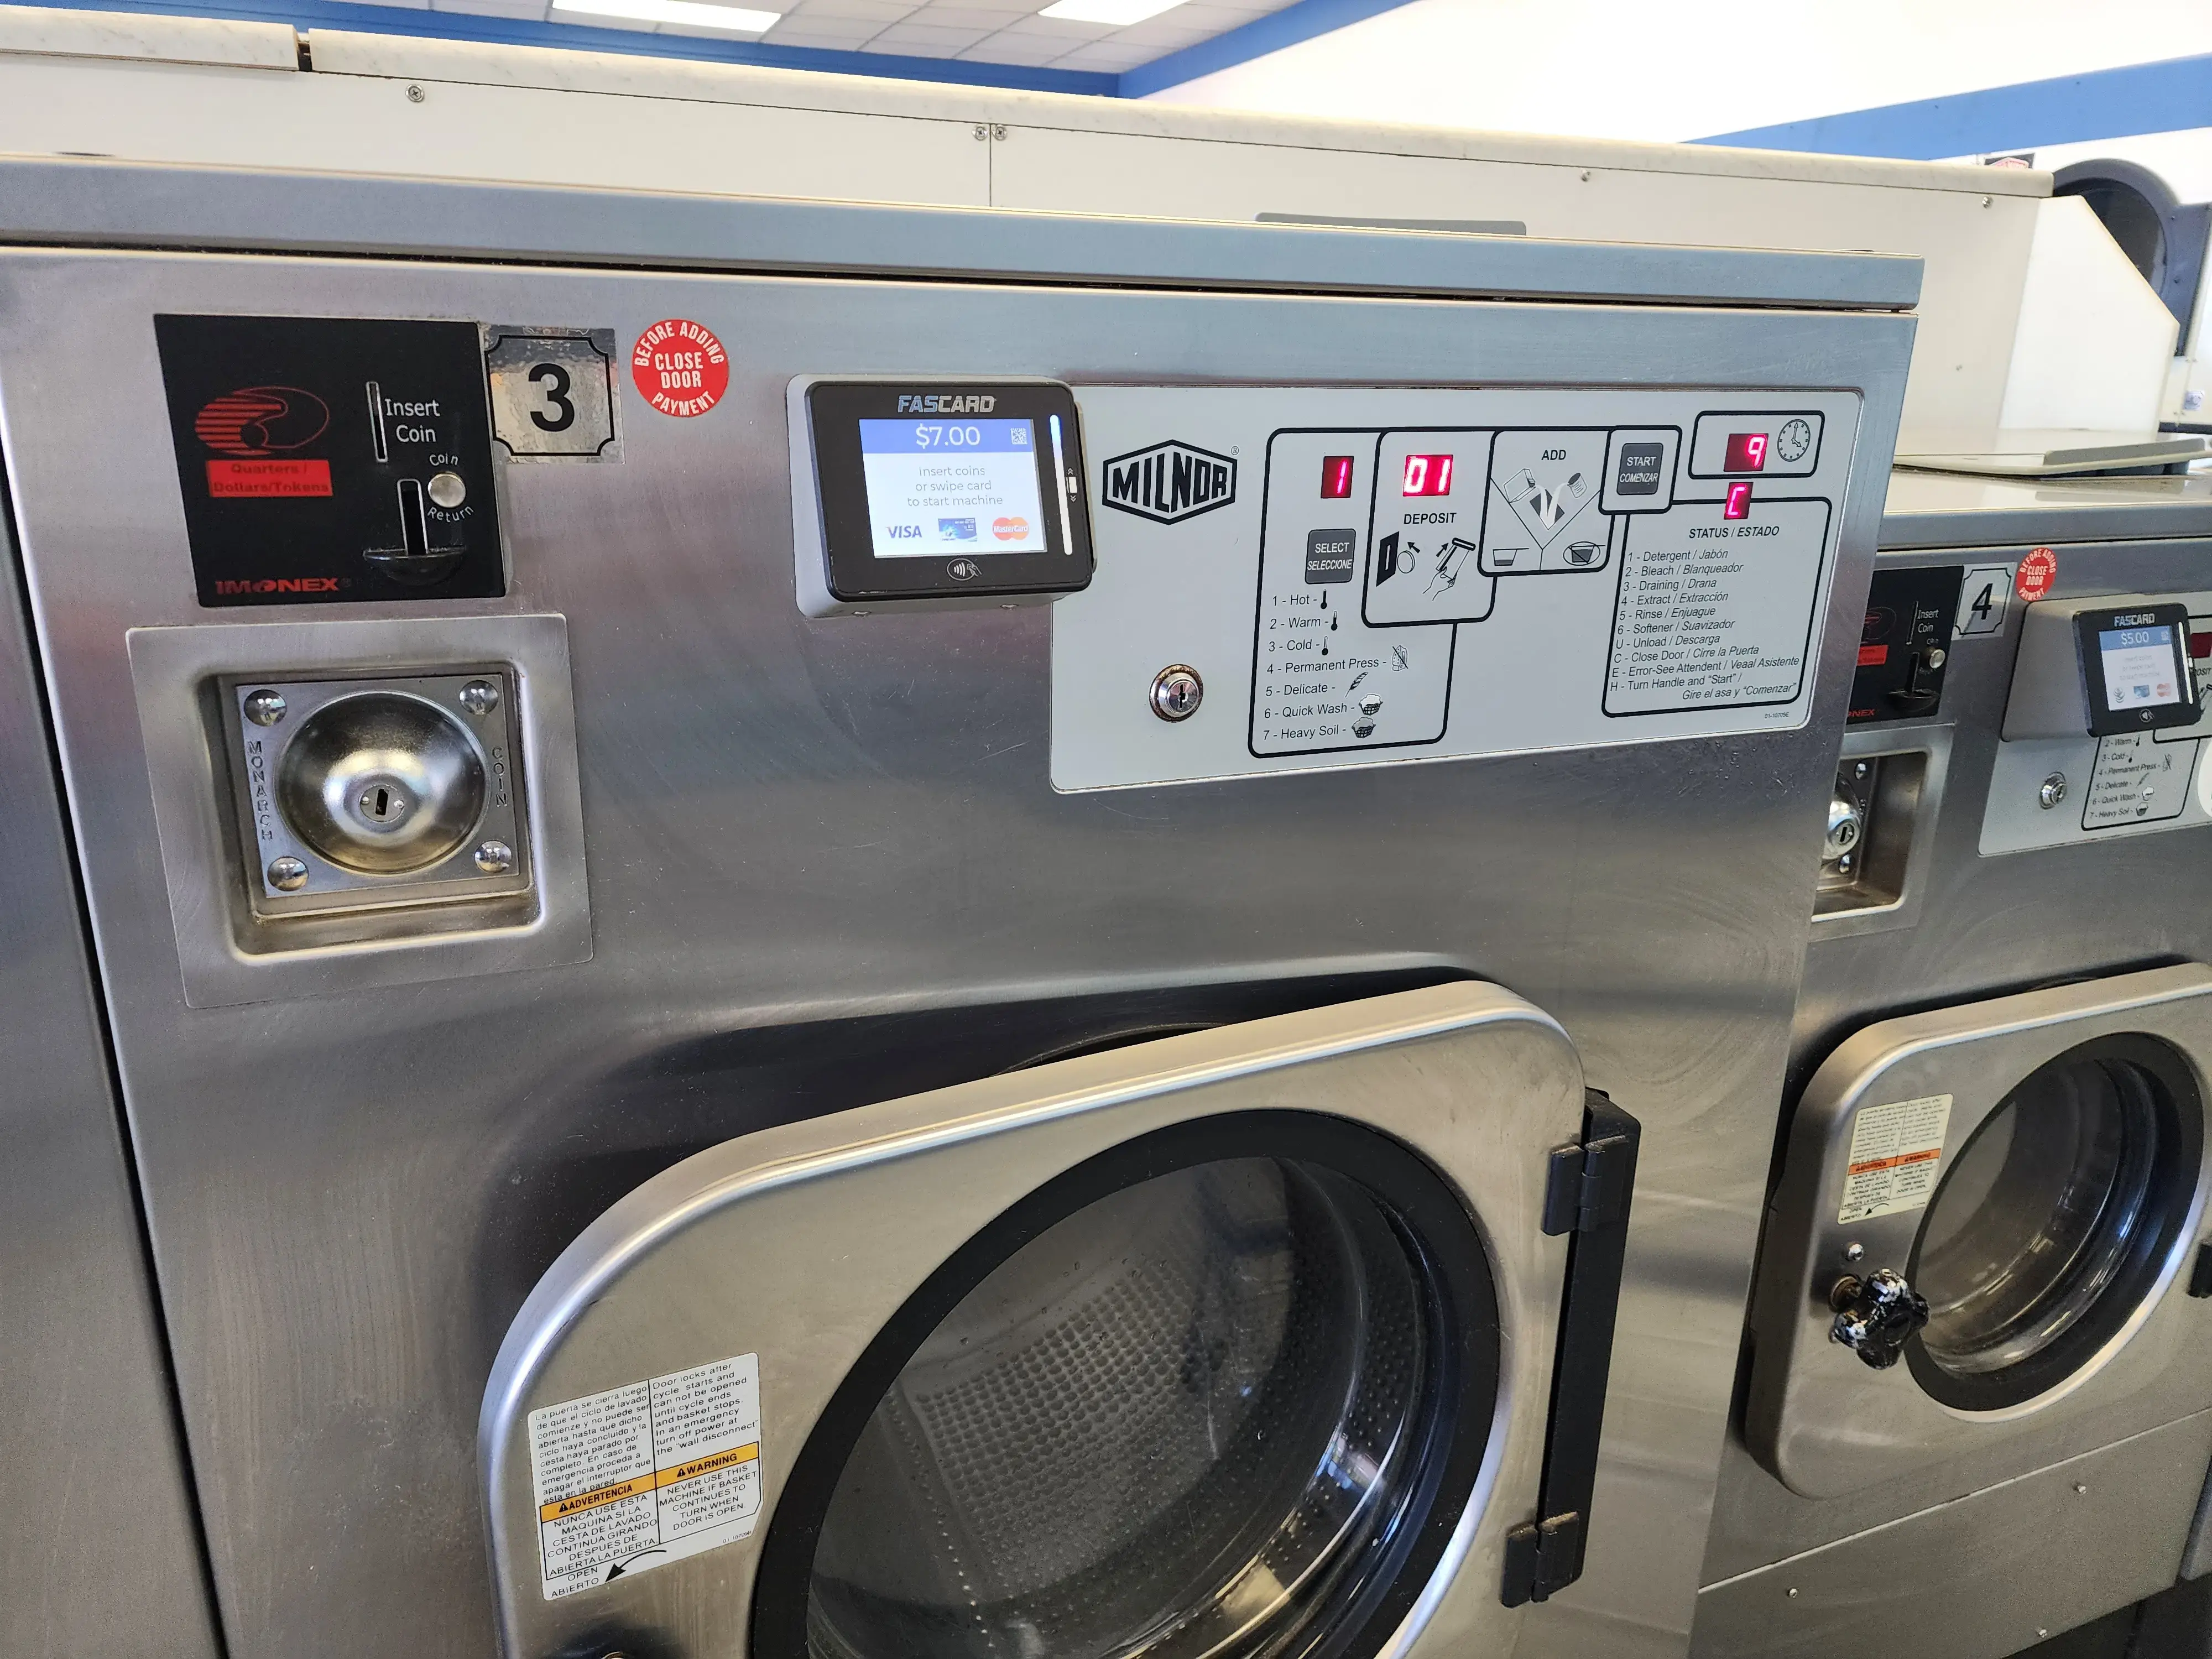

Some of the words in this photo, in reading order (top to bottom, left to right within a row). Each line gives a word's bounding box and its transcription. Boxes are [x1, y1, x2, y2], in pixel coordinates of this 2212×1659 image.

[635, 322, 675, 367] BEFORE
[680, 322, 724, 364] ADDING
[655, 352, 703, 371] CLOSE
[660, 371, 702, 389] DOOR
[528, 363, 575, 432] 3
[652, 391, 715, 415] PAYMENT
[898, 395, 996, 413] FASCARD
[385, 399, 440, 417] Insert
[396, 426, 436, 443] Coin
[916, 423, 980, 448] $7.00
[1542, 449, 1567, 461] ADD
[1747, 436, 1766, 467] 9
[429, 455, 458, 467] Coin
[1626, 455, 1657, 468] START
[919, 466, 952, 476] Insert
[956, 467, 985, 476] coins
[1619, 472, 1658, 484] COMENZAR
[915, 483, 927, 491] or
[931, 482, 963, 493] swipe
[967, 481, 992, 491] card
[1113, 452, 1227, 513] MILNOR
[907, 497, 920, 507] to
[923, 497, 949, 507] start
[952, 495, 1003, 505] machine
[427, 506, 474, 523] Return
[1403, 512, 1457, 525] DEPOSIT
[886, 525, 922, 539] VISA
[1689, 528, 1728, 538] STATUS
[1737, 526, 1779, 536] ESTADO
[1314, 542, 1349, 553] SELECT
[1628, 552, 1632, 561] 1
[1643, 550, 1691, 563] Detergent
[1699, 548, 1728, 559] Jabón
[1307, 559, 1352, 570] SELECCIONE
[1625, 566, 1631, 577] 2
[1641, 565, 1673, 576] Bleach
[1683, 562, 1744, 575] Blanqueador
[1623, 581, 1629, 591] 3
[1639, 580, 1679, 591] Draining
[1687, 578, 1717, 588] Drana
[1272, 595, 1276, 606] 1
[1290, 594, 1310, 605] Hot
[1621, 596, 1627, 606] 4
[1637, 594, 1671, 604] Extract
[1679, 591, 1728, 603] Extracción
[1970, 583, 1994, 620] 4
[1619, 611, 1625, 620] 5
[1635, 609, 1662, 619] Rinse
[1671, 607, 1715, 619] Enjuague
[1917, 609, 1939, 619] Insert
[2114, 613, 2155, 627] FASCARD
[1270, 618, 1276, 629] 2
[1288, 617, 1320, 628] Warm
[1618, 625, 1624, 634] 6
[1633, 623, 1673, 633] Softener
[1682, 619, 1735, 630] Suavizador
[1918, 623, 1934, 633] Coin
[1269, 641, 1275, 651] 3
[1287, 639, 1312, 650] Cold
[1616, 639, 1623, 649] U
[1633, 636, 1666, 648] Unload
[1675, 635, 1720, 645] Descarga
[2121, 631, 2149, 645] $5.00
[1614, 653, 1621, 663] C
[1631, 652, 1658, 661] Close
[1661, 650, 1684, 660] Door
[1693, 648, 1715, 658] Cirre
[1717, 647, 1726, 656] la
[1729, 645, 1759, 655] Puerta
[1266, 664, 1273, 674] 4
[1285, 659, 1345, 673] Permanent
[1349, 658, 1379, 669] Press
[1612, 667, 1619, 677] E
[1629, 664, 1674, 676] Error-See
[1676, 661, 1721, 672] Attendent
[1756, 656, 1799, 667] Asistente
[1266, 686, 1272, 696] 5
[1284, 683, 1327, 695] Delicate
[1610, 681, 1618, 691] H
[1627, 680, 1648, 690] Turn
[1651, 677, 1684, 688] Handle
[1687, 675, 1705, 685] and
[1682, 690, 1701, 700] Gire
[1704, 688, 1713, 698] el
[1733, 688, 1740, 698] y
[1264, 708, 1270, 718] 6
[1282, 705, 1313, 717] Quick
[1317, 702, 1347, 714] Wash
[1263, 730, 1269, 740] 7
[1281, 728, 1315, 739] Heavy
[1319, 724, 1338, 735] Soil
[492, 747, 507, 807] COIN
[248, 741, 273, 841] MONARCH
[653, 1378, 676, 1389] Door
[680, 1371, 705, 1381] locks
[709, 1363, 732, 1374] after
[653, 1387, 679, 1399] cycle
[686, 1378, 713, 1390] starts
[717, 1371, 734, 1381] and
[654, 1398, 671, 1408] can
[675, 1392, 690, 1402] not
[710, 1376, 746, 1392] opened
[655, 1406, 675, 1417] until
[679, 1400, 703, 1411] cycle
[708, 1392, 731, 1402] ends
[655, 1416, 674, 1427] and
[677, 1406, 709, 1421] basket
[686, 1453, 737, 1474] WARNING
[659, 1486, 705, 1506] MACHINE
[719, 1470, 756, 1488] BASKET
[667, 1479, 701, 1495] NEVER
[704, 1472, 723, 1483] USE
[726, 1465, 747, 1476] THIS
[569, 1484, 632, 1510] ADVERTENCIA
[672, 1488, 730, 1511] CONTINUES
[732, 1484, 745, 1492] TO
[680, 1505, 706, 1518] TURN
[709, 1495, 738, 1509] WHEN
[673, 1516, 702, 1530] DOOR
[567, 1566, 597, 1580] OPEN
[551, 1577, 600, 1598] ABIERTO
